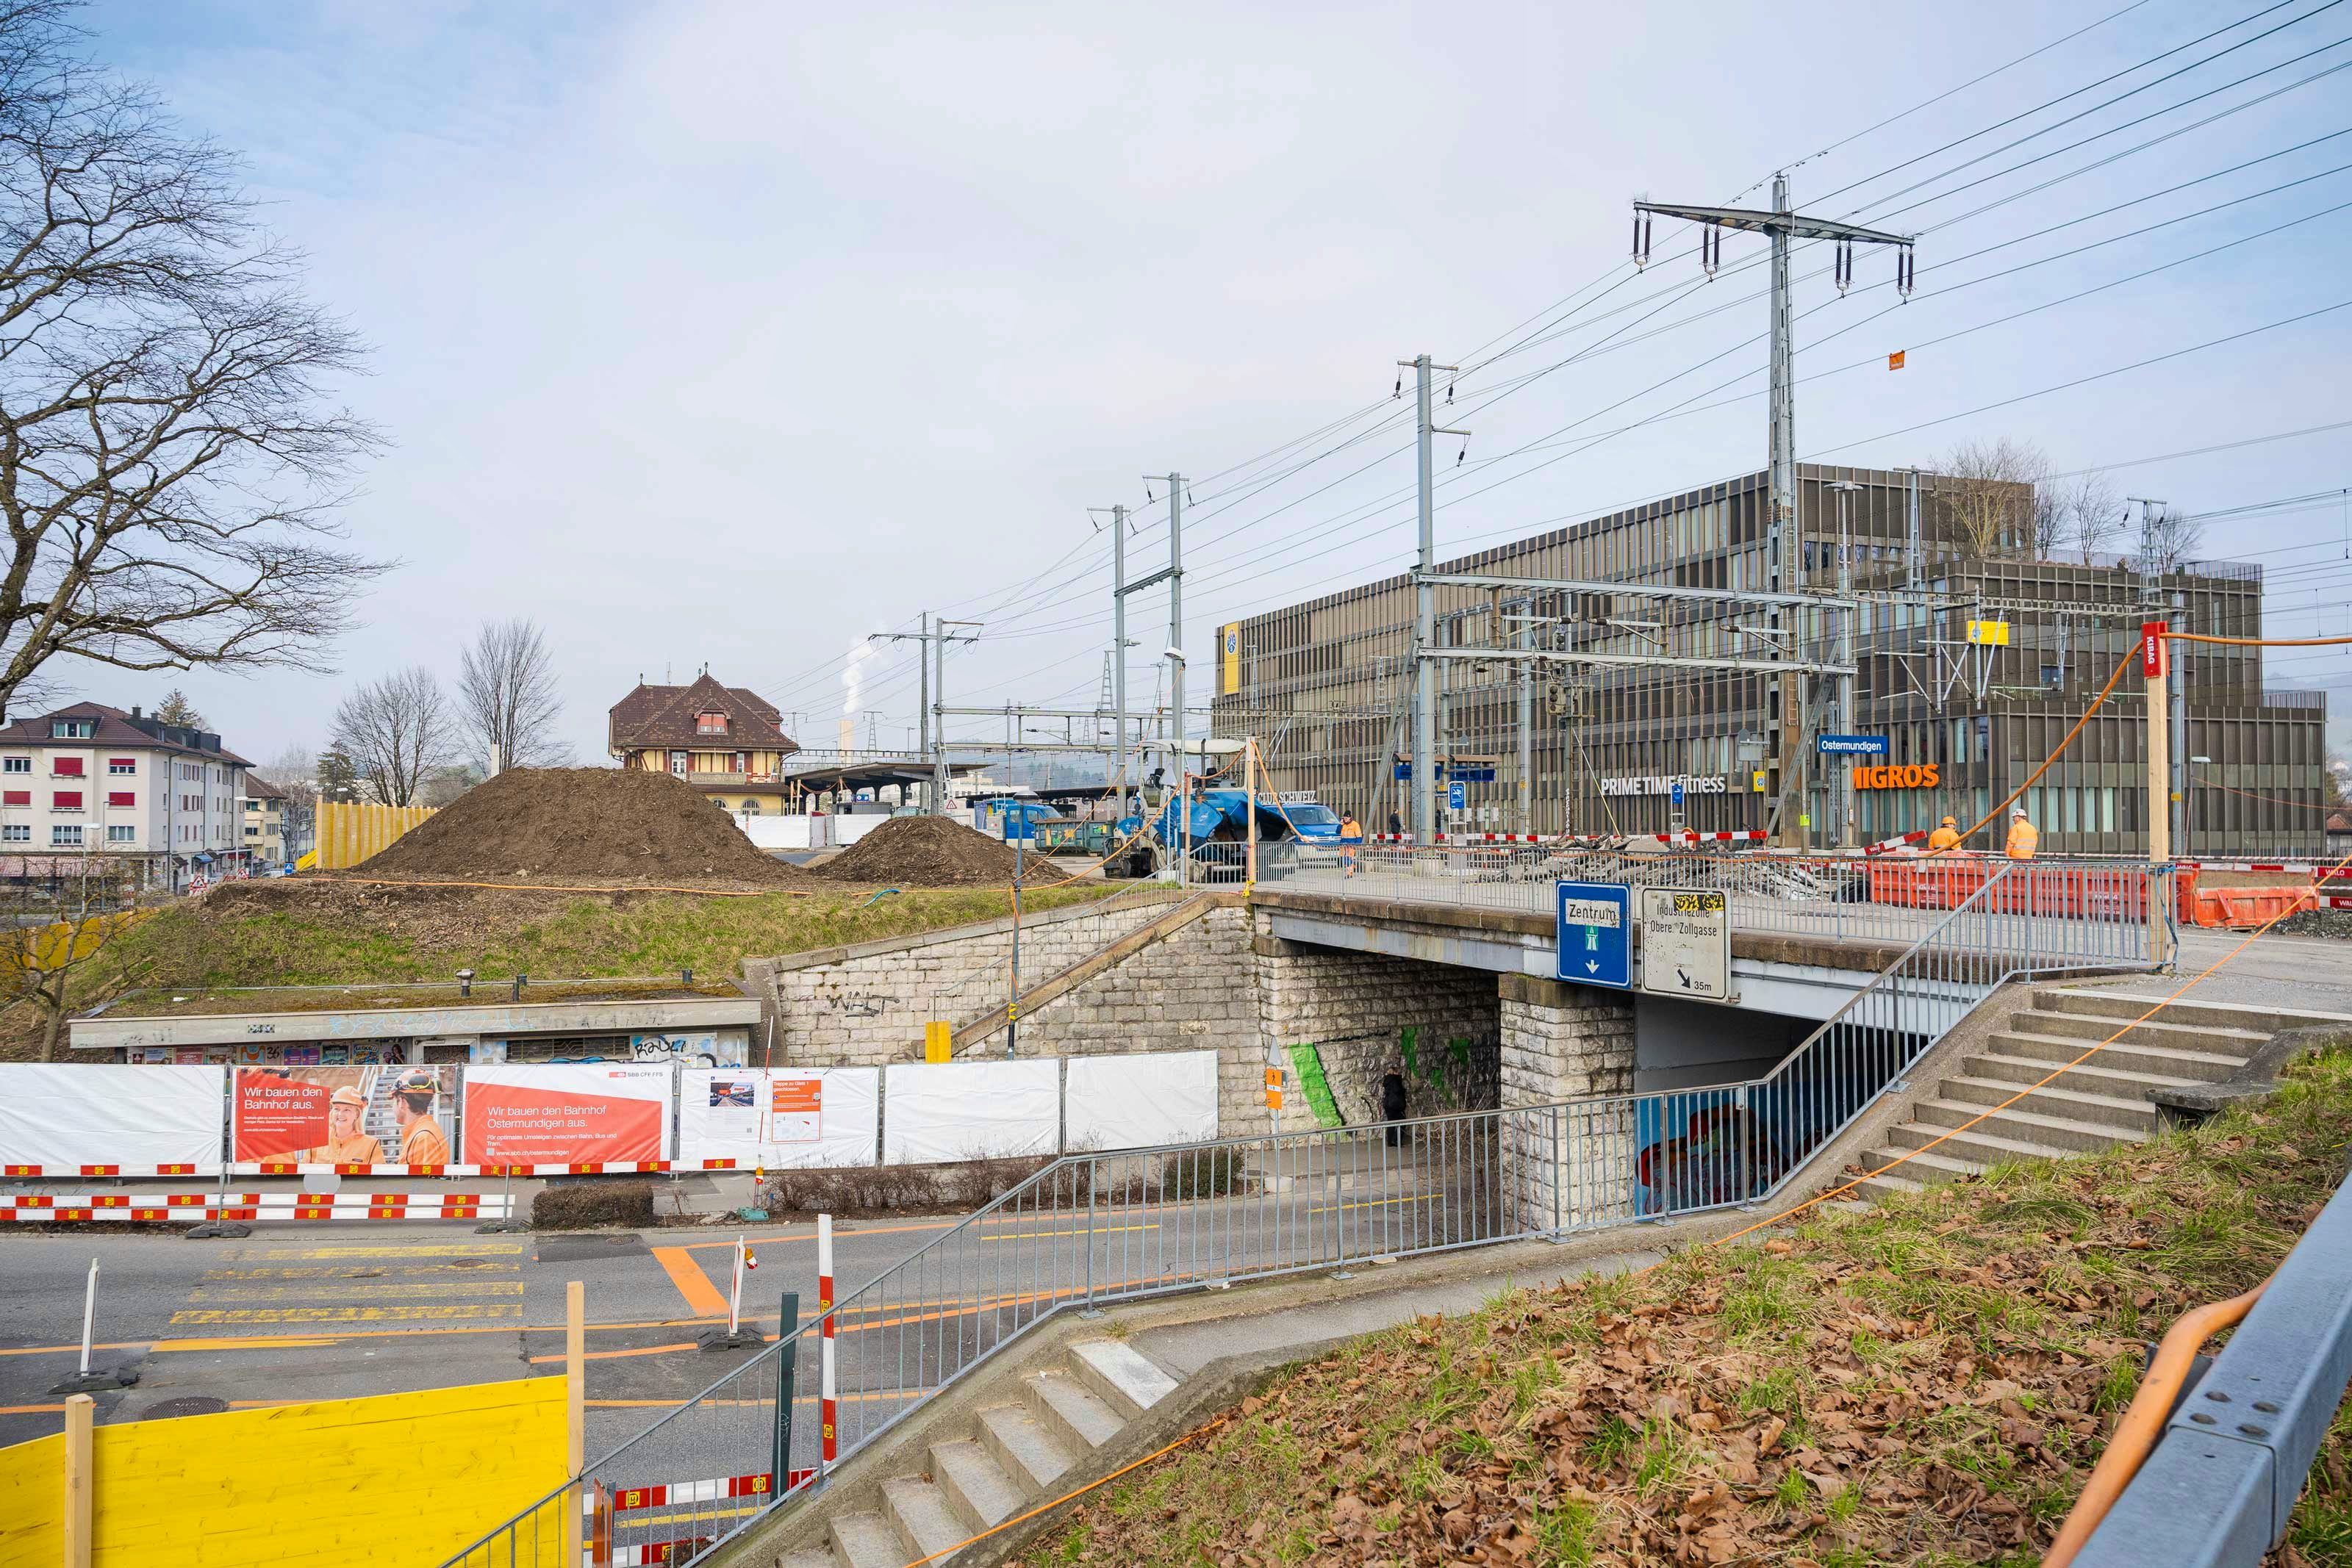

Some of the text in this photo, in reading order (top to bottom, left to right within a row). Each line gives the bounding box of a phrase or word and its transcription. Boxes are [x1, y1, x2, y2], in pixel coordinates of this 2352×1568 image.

[2146, 636, 2155, 664] KIBAG
[1821, 740, 1882, 752] Ostermundigen
[1601, 777, 1642, 796] PRIME
[1677, 774, 1726, 794] fitness
[1279, 790, 1316, 803] SCHWEIZ
[1569, 904, 1616, 921] Zentrum
[1679, 921, 1718, 938] Zollgasse
[1694, 981, 1712, 991] 35m
[244, 1087, 323, 1097] Wir bauen den
[244, 1099, 315, 1110] Bahnhof aus.
[487, 1104, 607, 1116] Wir bauen den Bahnhof
[487, 1118, 588, 1129] Ostermundigen aus.
